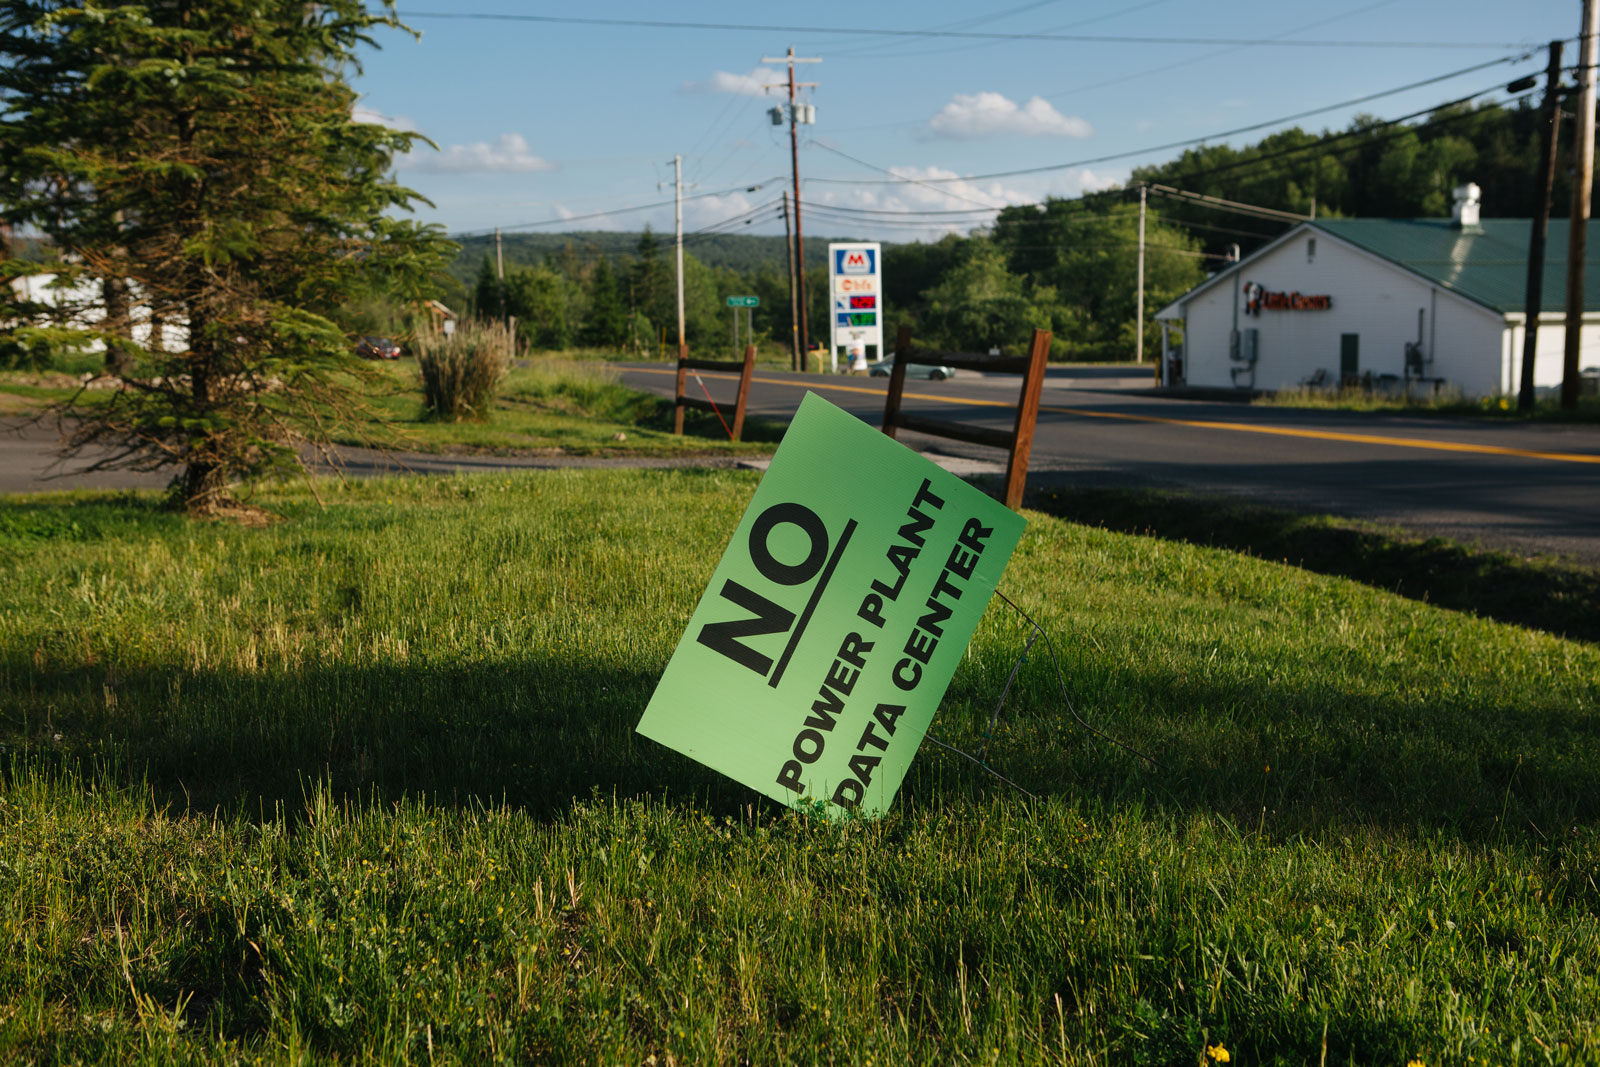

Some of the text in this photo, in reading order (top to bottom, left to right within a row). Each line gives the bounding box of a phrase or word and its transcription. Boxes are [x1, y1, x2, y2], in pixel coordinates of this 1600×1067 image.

[848, 254, 865, 265] M
[696, 502, 829, 677] NO
[775, 478, 946, 795] POWER PLANT
[831, 517, 994, 809] DATA CENTER
